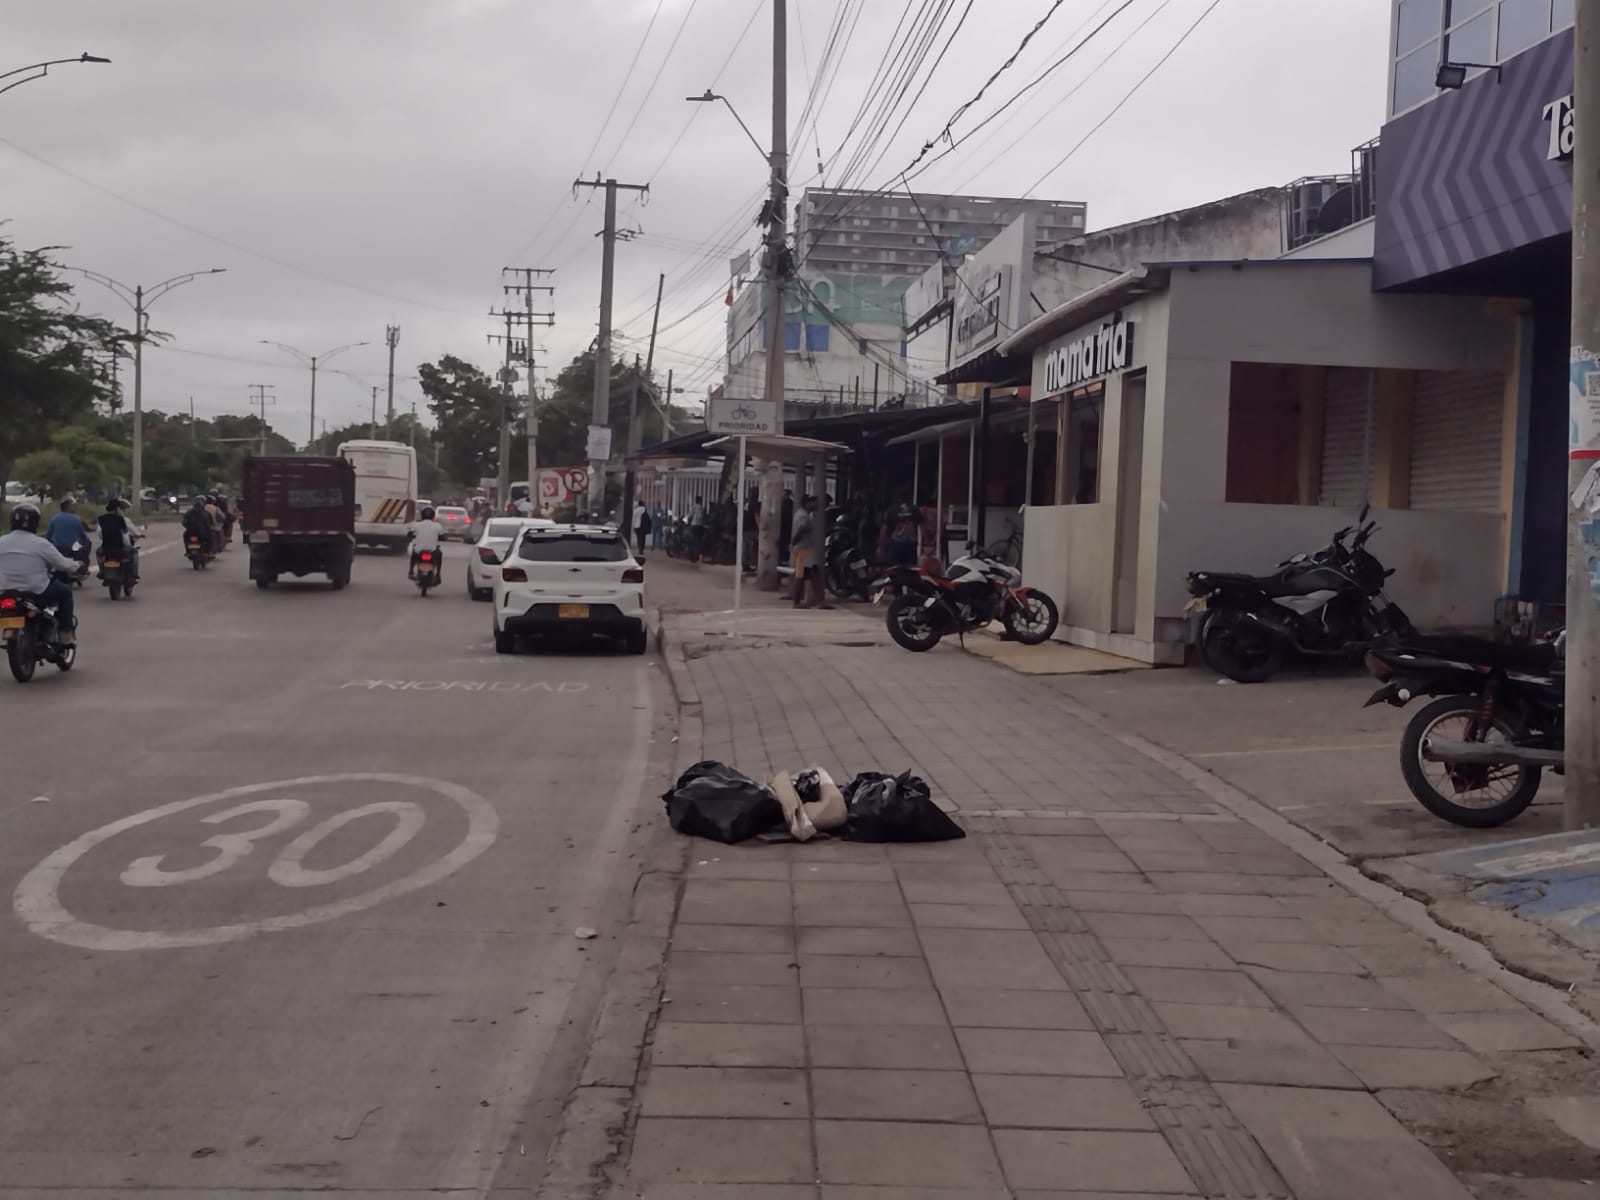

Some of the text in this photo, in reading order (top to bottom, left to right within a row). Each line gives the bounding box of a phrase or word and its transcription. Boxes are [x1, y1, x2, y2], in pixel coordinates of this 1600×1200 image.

[719, 421, 768, 432] PRIORIDAD
[339, 679, 589, 692] PRIORIDAD
[119, 799, 427, 888] 30
